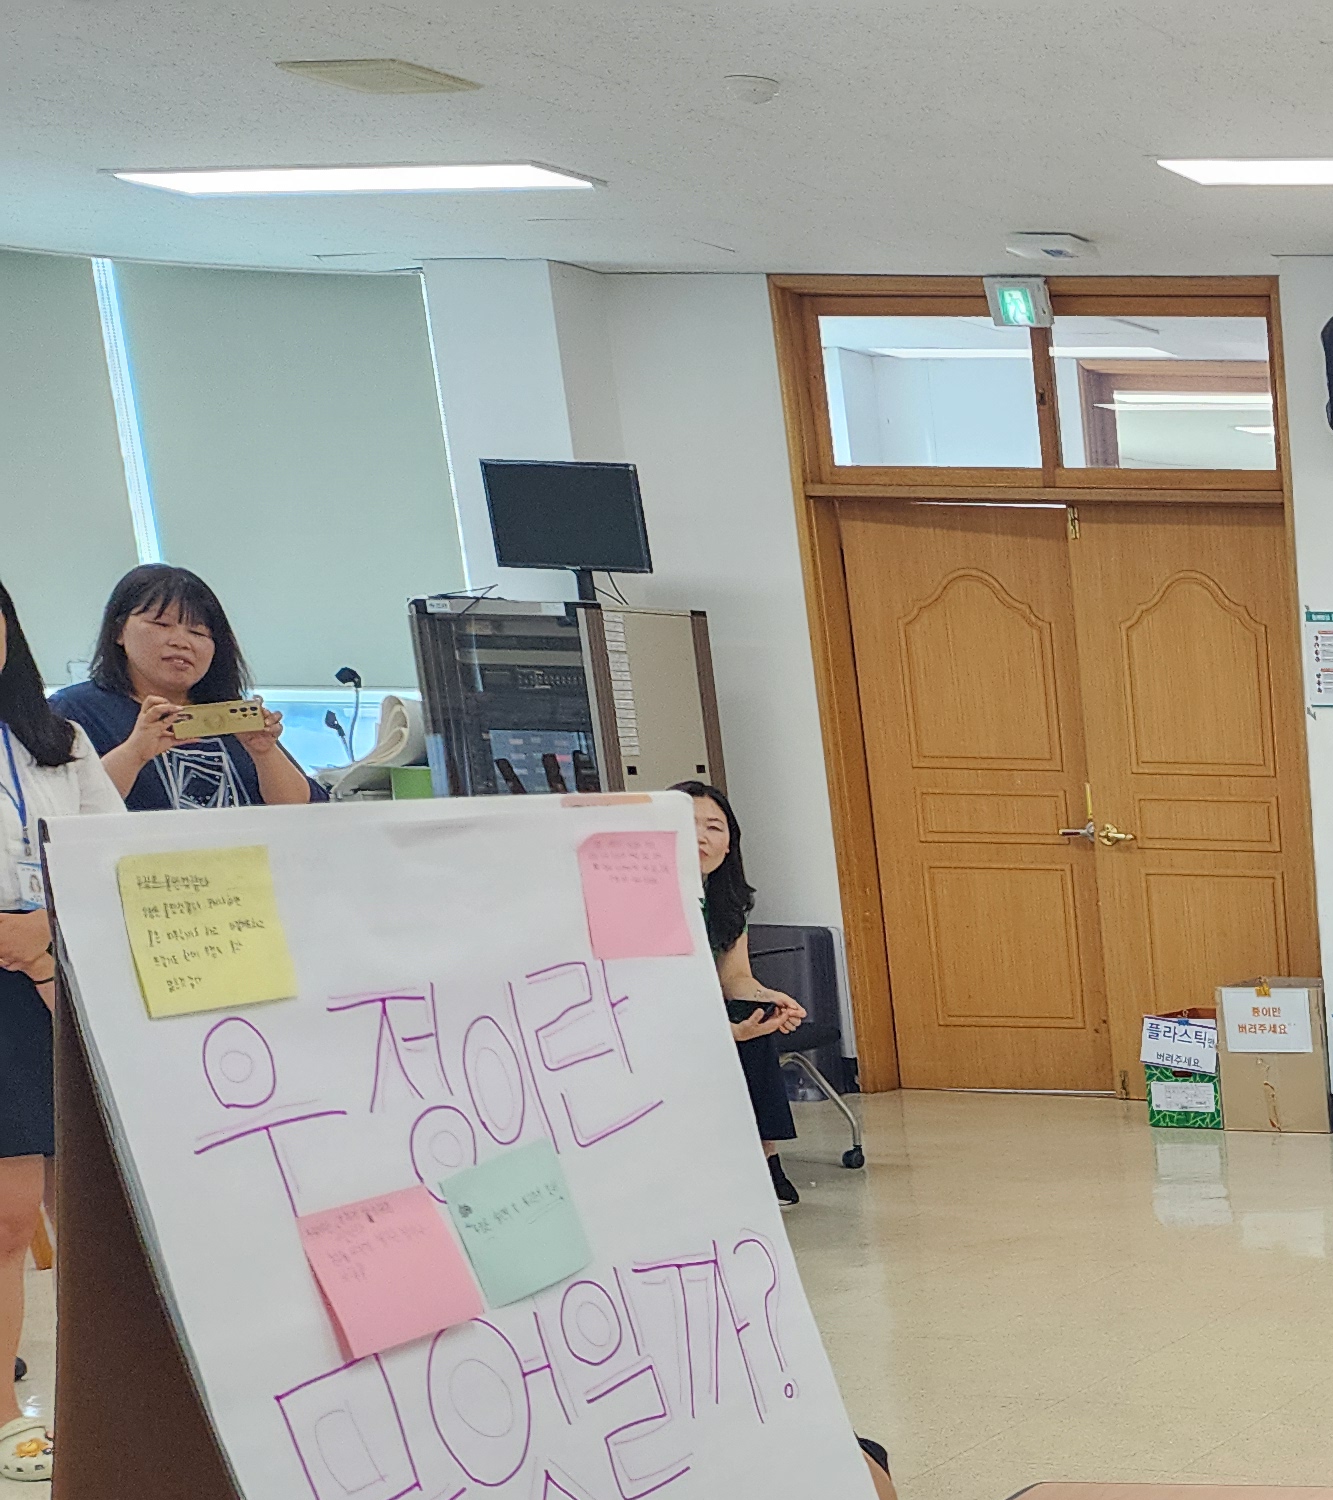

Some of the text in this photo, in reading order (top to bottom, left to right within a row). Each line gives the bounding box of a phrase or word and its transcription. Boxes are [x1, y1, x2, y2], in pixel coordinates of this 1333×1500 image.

[1251, 1005, 1282, 1019] 종이만
[1237, 1023, 1289, 1035] 버려주세요
[194, 958, 665, 1218] 우정이란
